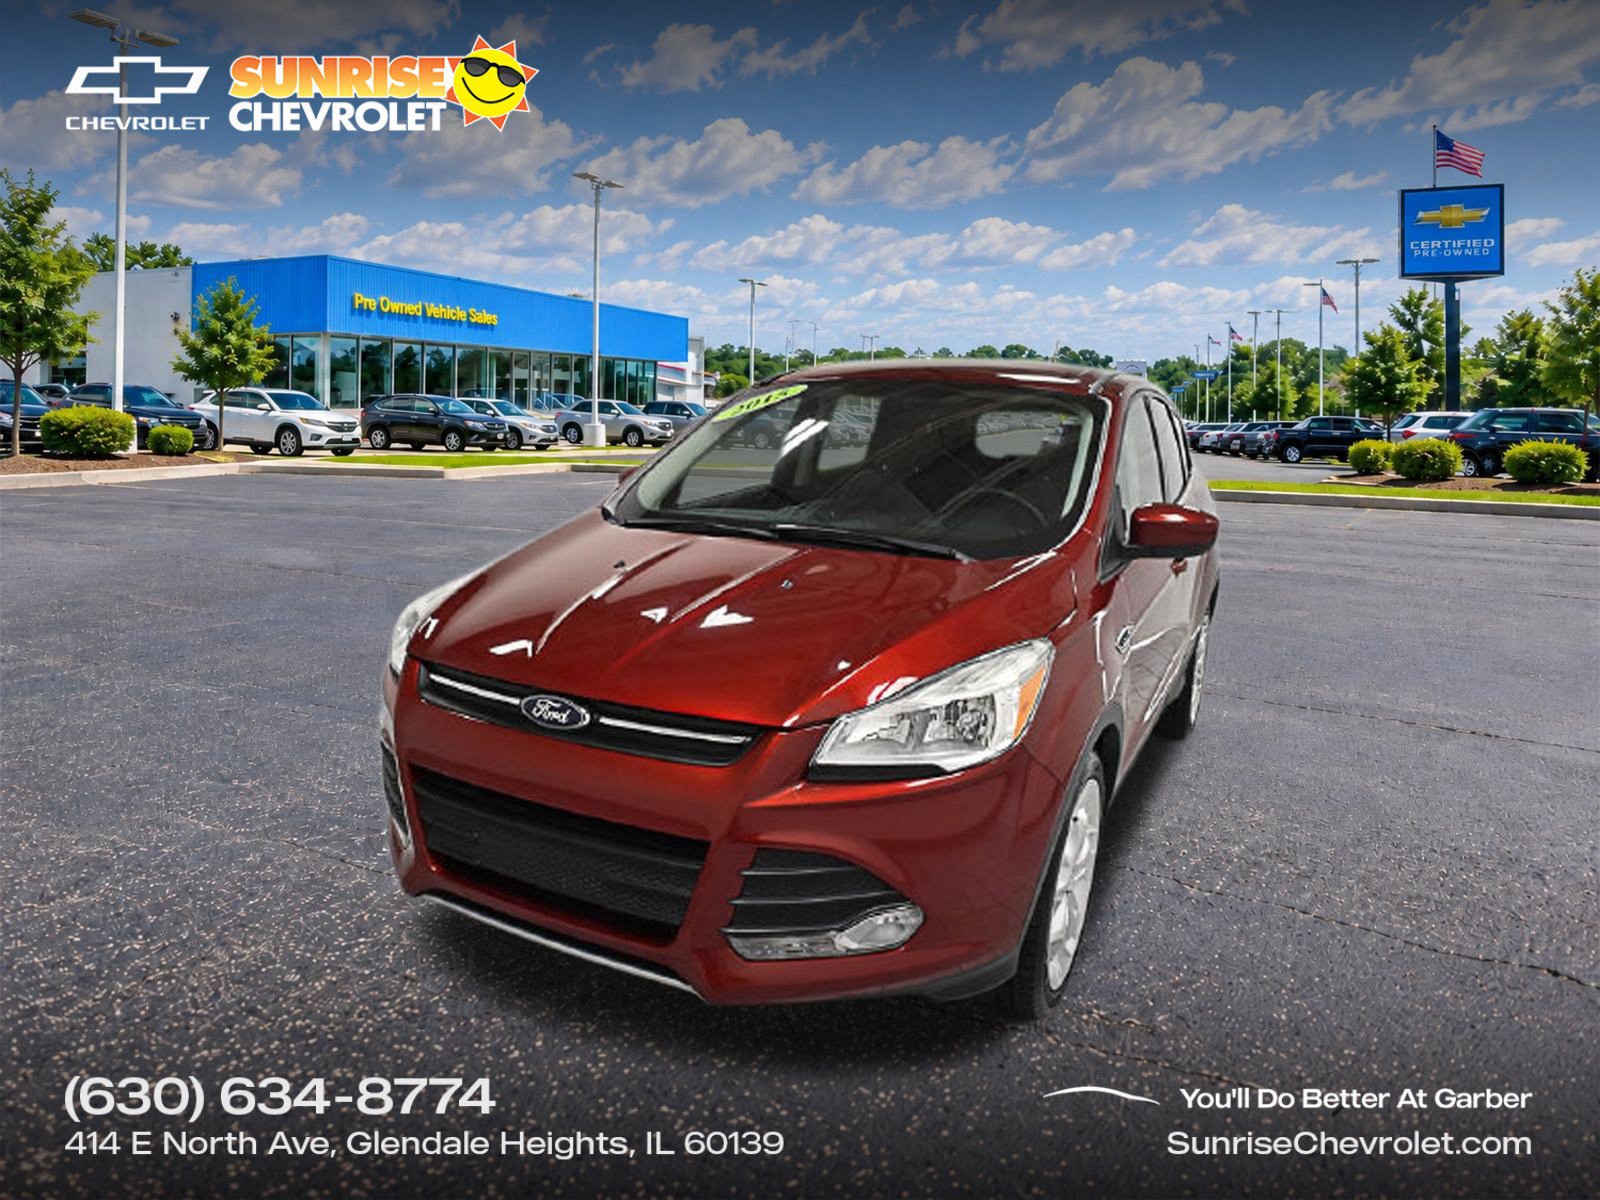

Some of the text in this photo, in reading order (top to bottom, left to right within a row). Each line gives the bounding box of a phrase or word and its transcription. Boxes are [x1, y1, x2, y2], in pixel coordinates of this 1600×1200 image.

[1410, 238, 1495, 250] CERTIFIED
[1413, 247, 1490, 257] PRE-OWNED
[354, 293, 498, 326] Pre Owned Vehicle Sales
[532, 699, 572, 724] Ford
